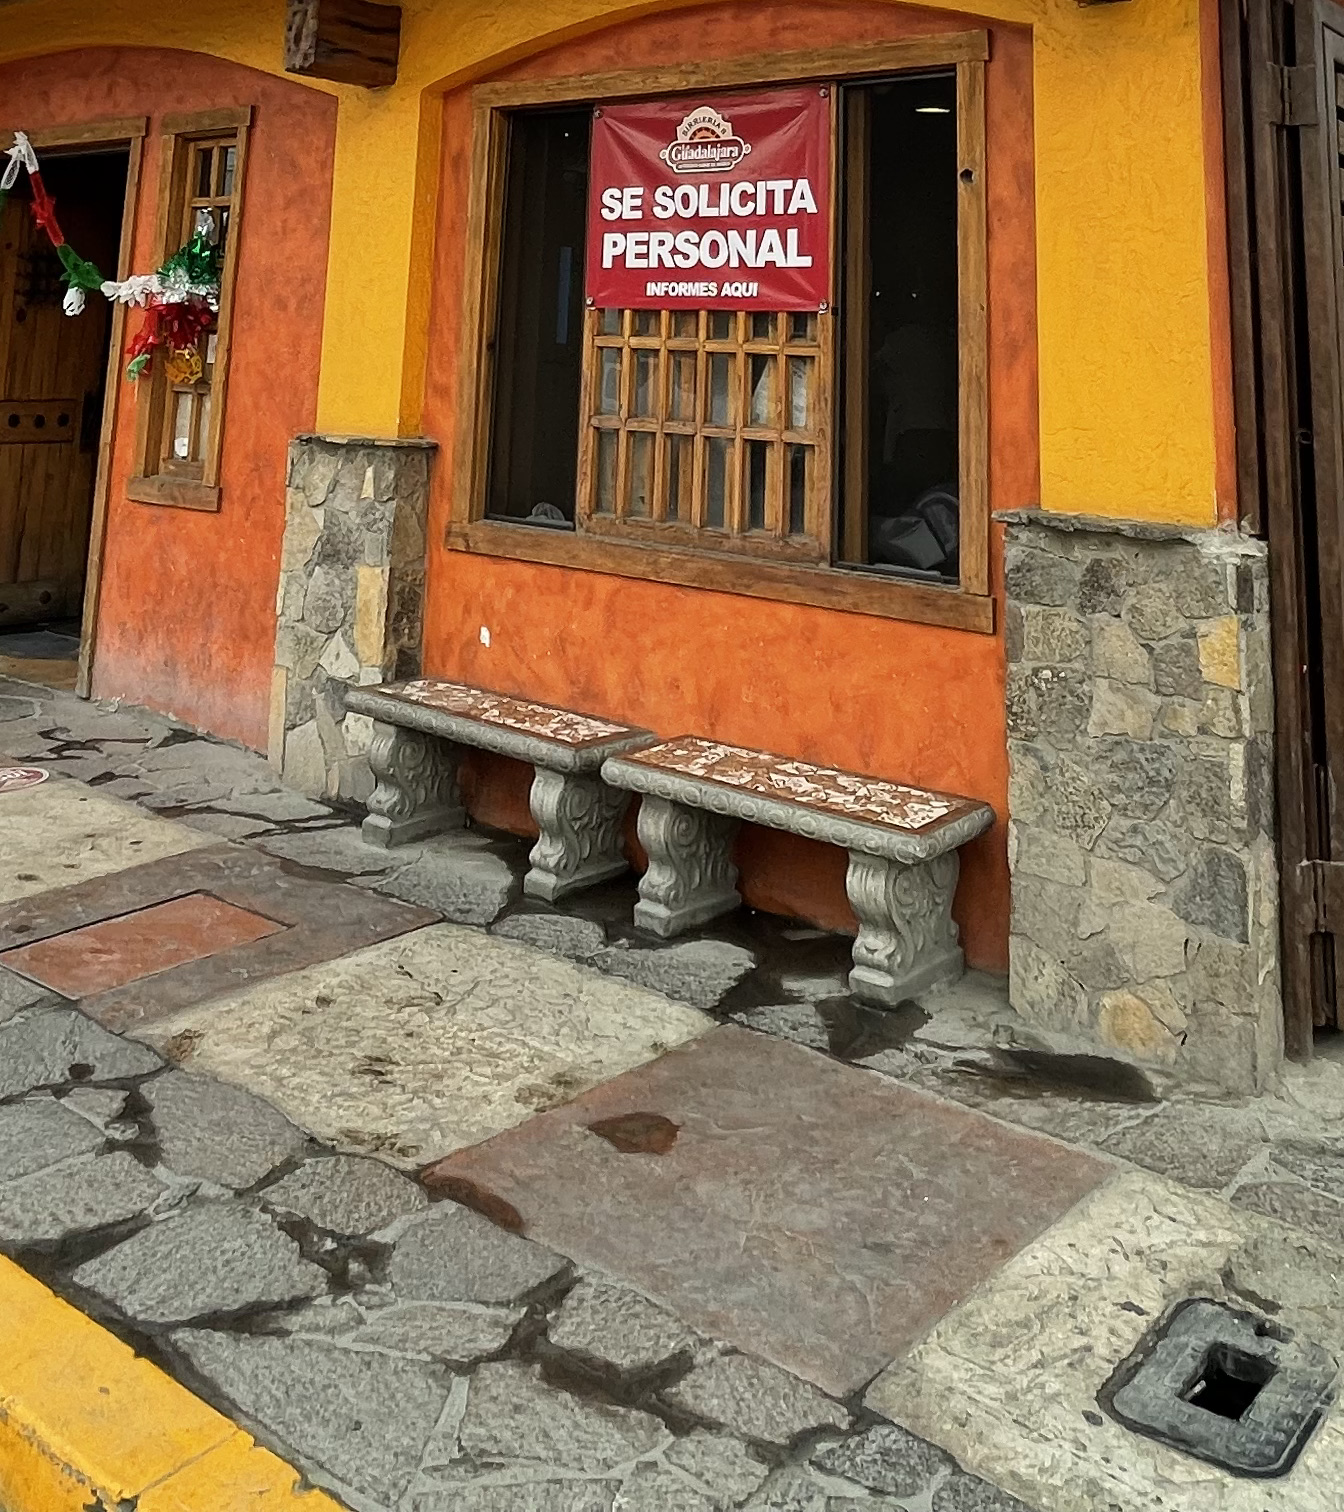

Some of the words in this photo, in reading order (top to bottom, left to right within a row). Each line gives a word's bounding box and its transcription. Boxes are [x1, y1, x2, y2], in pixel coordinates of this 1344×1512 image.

[681, 116, 722, 137] BIRRIERIA
[671, 143, 739, 161] Guadalajara
[600, 186, 644, 220] SE
[652, 178, 818, 219] SOLICITA
[602, 228, 813, 269] PERSONAL
[646, 282, 718, 297] INFORMES
[720, 282, 759, 298] AQUI
